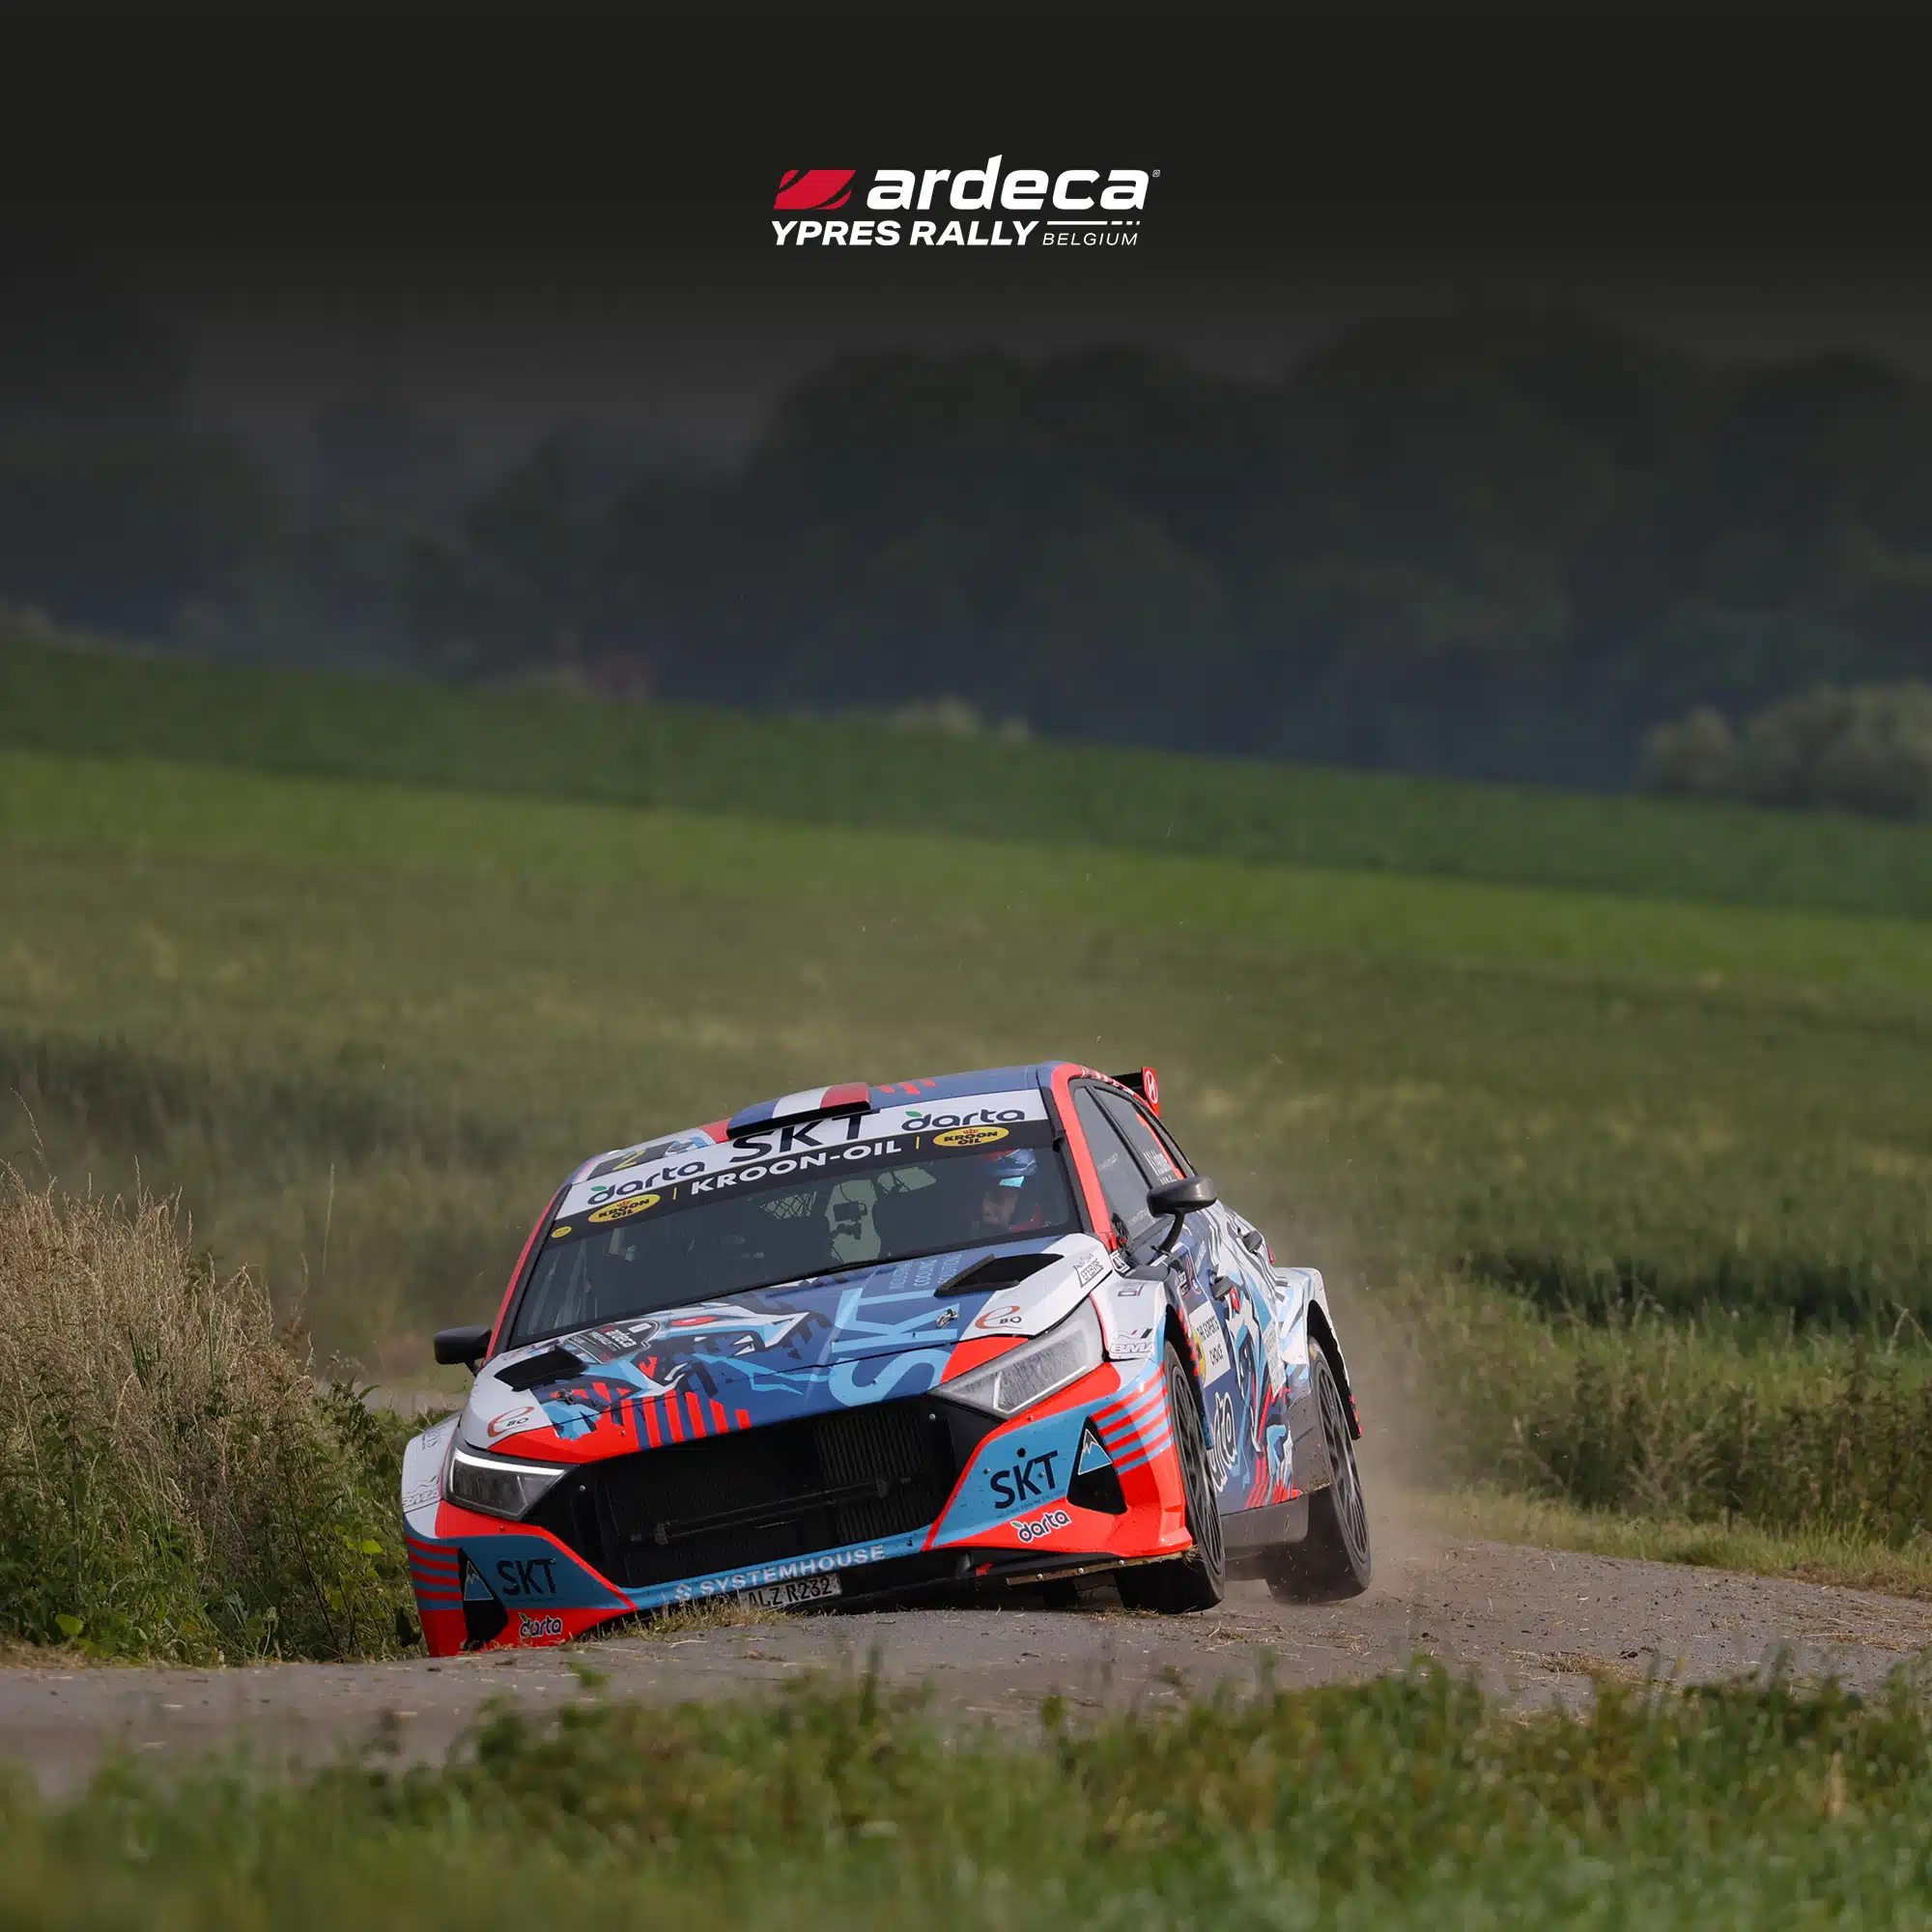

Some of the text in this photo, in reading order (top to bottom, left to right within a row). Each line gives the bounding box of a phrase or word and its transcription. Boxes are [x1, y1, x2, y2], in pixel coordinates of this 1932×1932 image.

[901, 1109, 1025, 1131] darta
[729, 1111, 880, 1162] SKT
[944, 1131, 998, 1142] KROON
[691, 1140, 901, 1195] KROON-OIL
[587, 1161, 705, 1205] darta
[599, 1199, 649, 1218] KROON
[611, 1208, 634, 1218] OIL
[914, 1259, 938, 1287] COOLING
[990, 1450, 1058, 1509] SKT
[1017, 1510, 1070, 1543] darta
[497, 1558, 556, 1596] SKT
[699, 1545, 886, 1597] SYSTEMHOUSE
[786, 1576, 833, 1603] R232
[519, 1615, 563, 1638] darta
